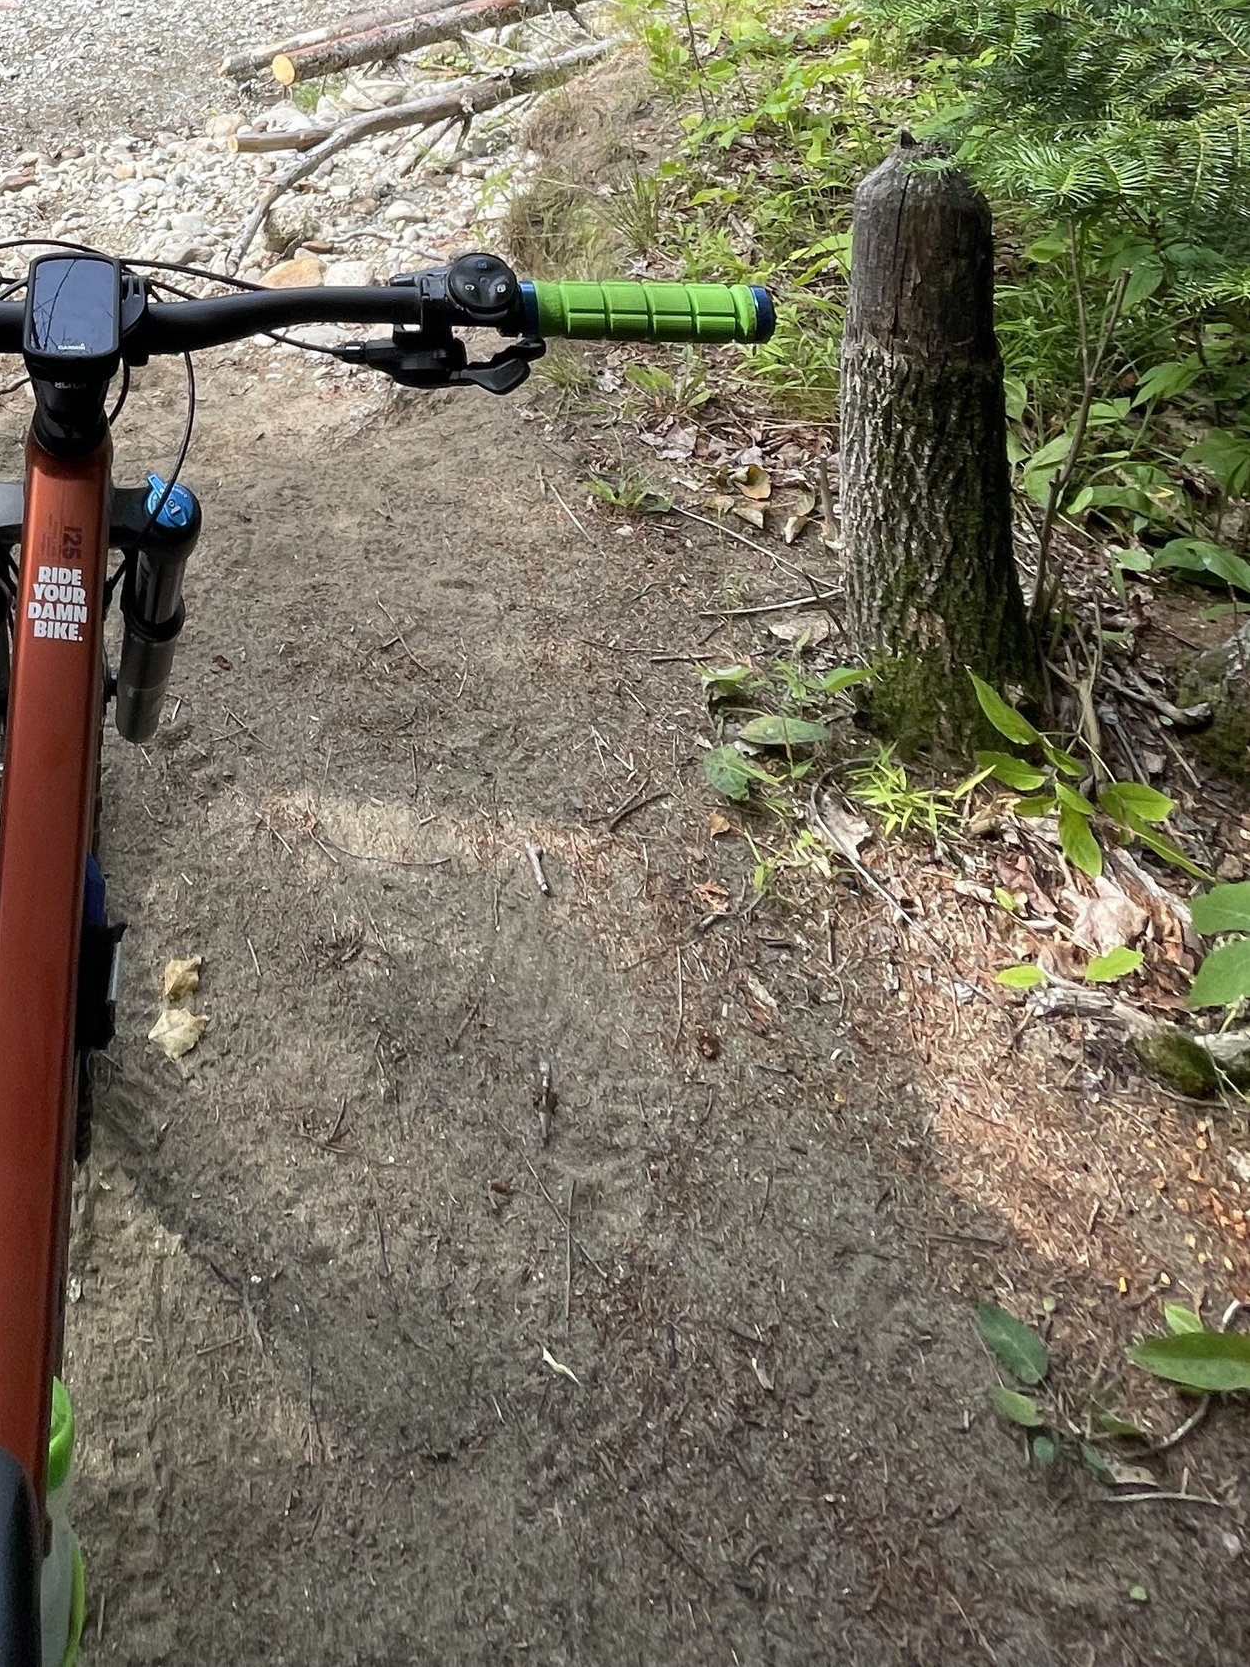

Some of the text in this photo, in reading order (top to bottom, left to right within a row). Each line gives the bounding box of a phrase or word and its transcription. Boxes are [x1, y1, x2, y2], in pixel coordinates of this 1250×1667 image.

[38, 566, 83, 586] RIDE
[32, 583, 86, 604] YOUR
[28, 602, 88, 623] DAMN
[33, 620, 83, 642] BIKE.
